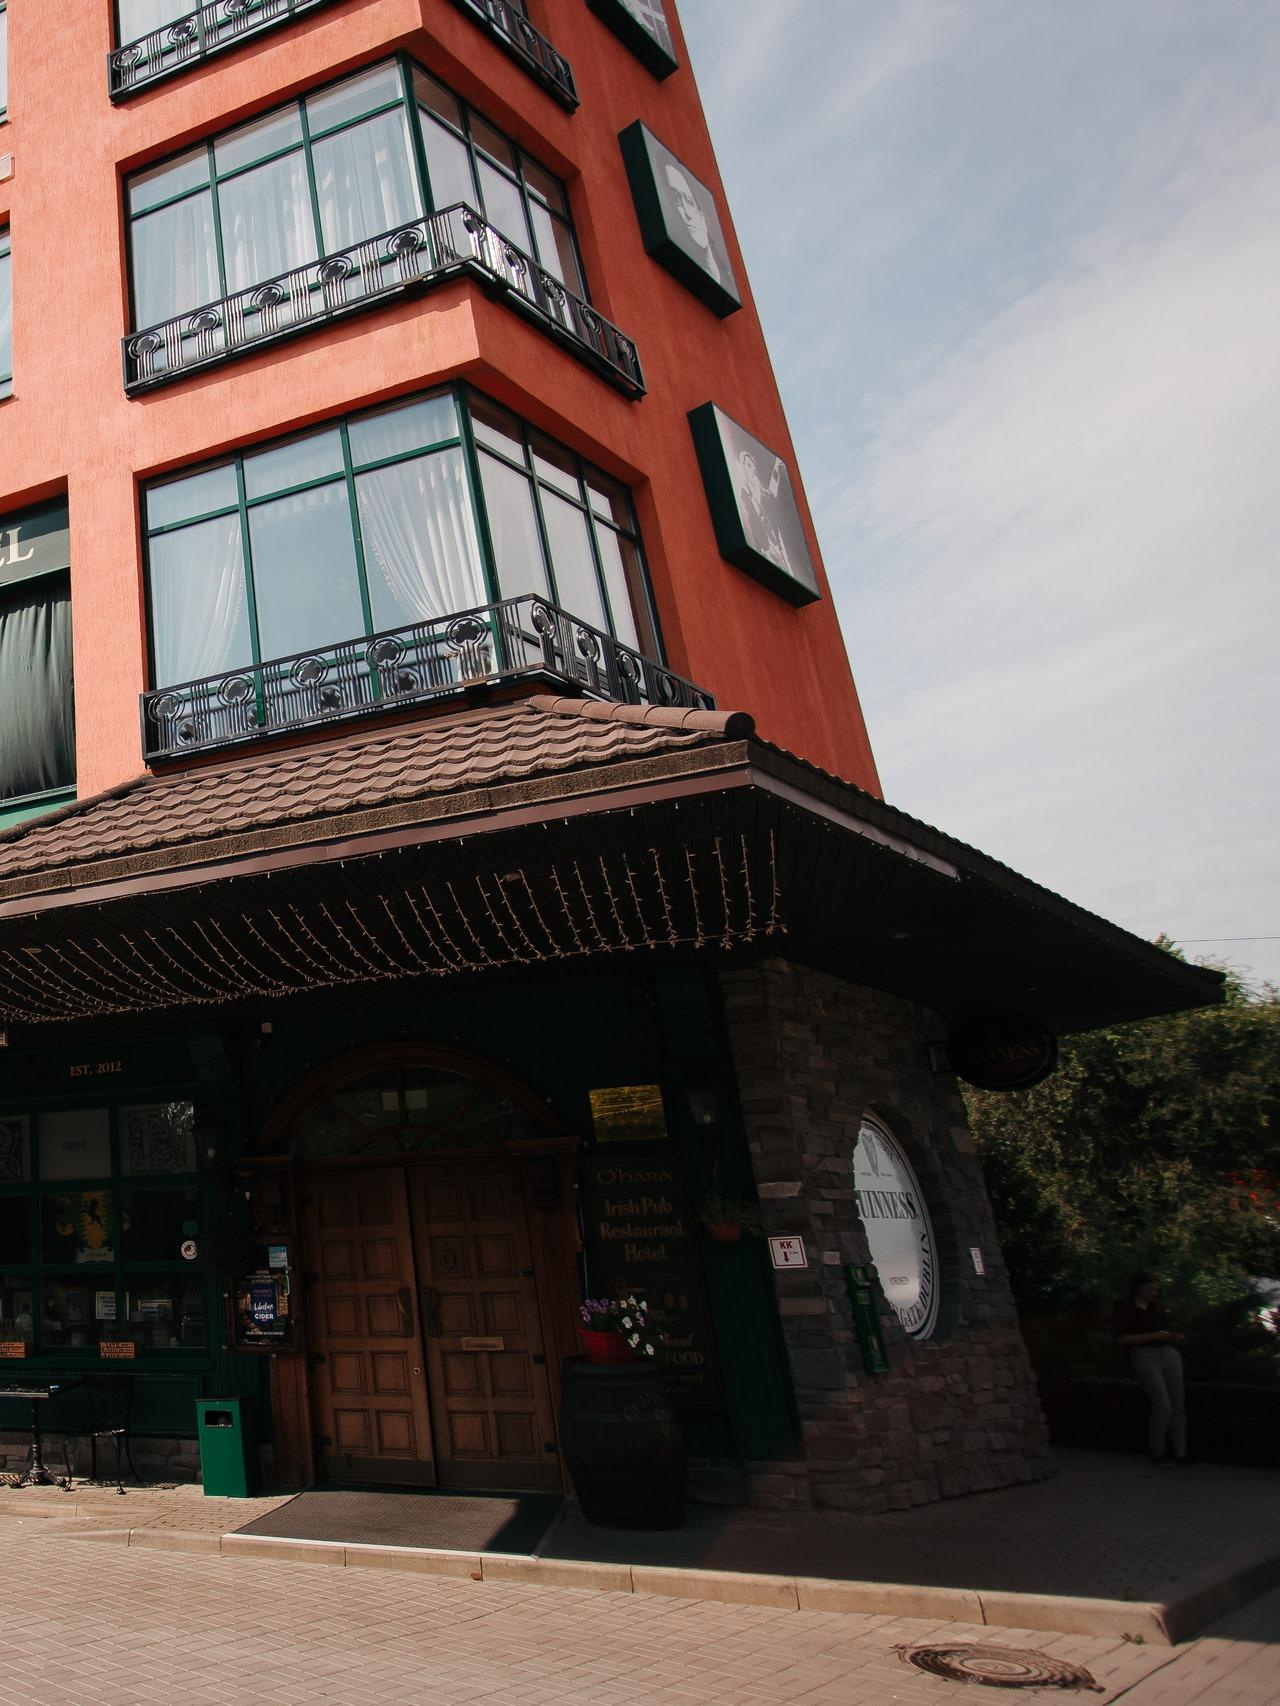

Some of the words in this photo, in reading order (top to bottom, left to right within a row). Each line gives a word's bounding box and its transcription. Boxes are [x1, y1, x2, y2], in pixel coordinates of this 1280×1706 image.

[96, 1061, 123, 1074] 2012
[604, 1198, 640, 1217] Irish
[641, 1196, 673, 1217] Pub
[857, 1190, 918, 1220] UINNESS
[599, 1218, 686, 1241] Restaurant
[624, 1243, 667, 1264] Hotel
